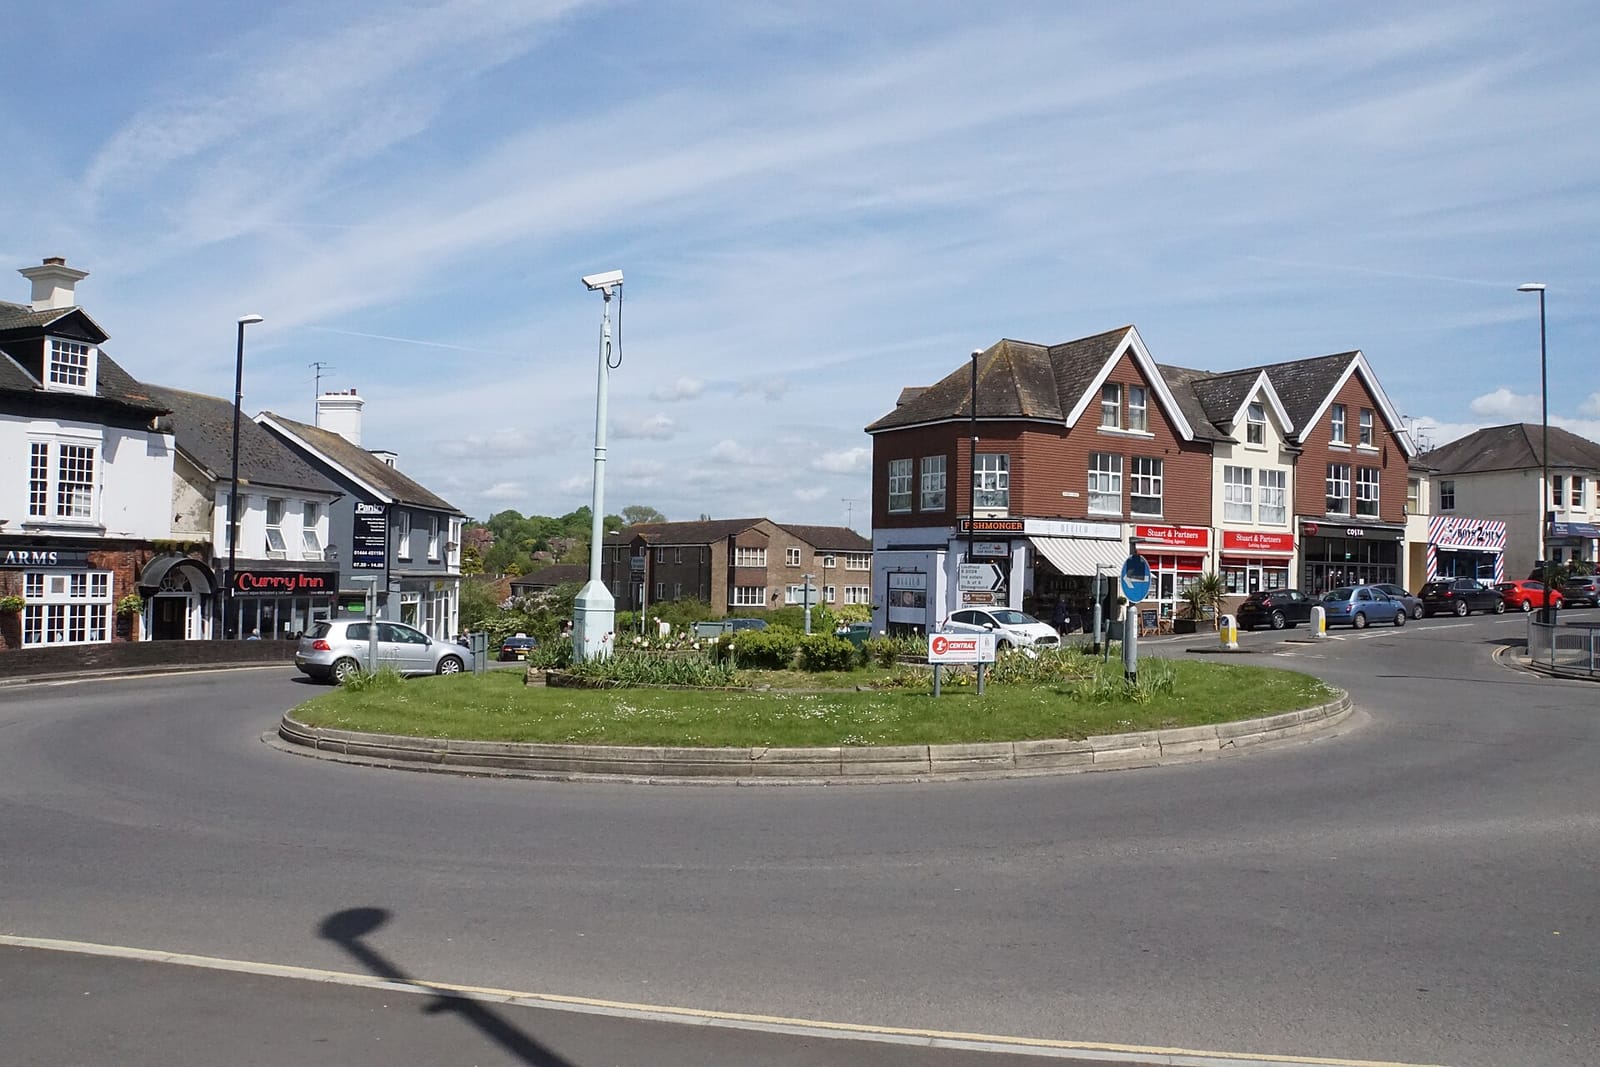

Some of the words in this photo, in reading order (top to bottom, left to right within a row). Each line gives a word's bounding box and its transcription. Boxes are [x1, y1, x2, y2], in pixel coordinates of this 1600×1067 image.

[358, 503, 385, 512] Pantry
[964, 522, 1023, 530] FSHMONGER
[1147, 528, 1166, 537] Stuart
[1167, 530, 1173, 538] &
[1174, 530, 1199, 539] Partners
[1346, 528, 1364, 537] COSTA
[1477, 526, 1485, 541] 2
[1236, 534, 1253, 542] Stuart
[1254, 534, 1259, 542] &
[1260, 534, 1281, 543] Partners
[4, 550, 58, 566] ARMS
[239, 572, 296, 590] Curry
[298, 573, 324, 588] Inn
